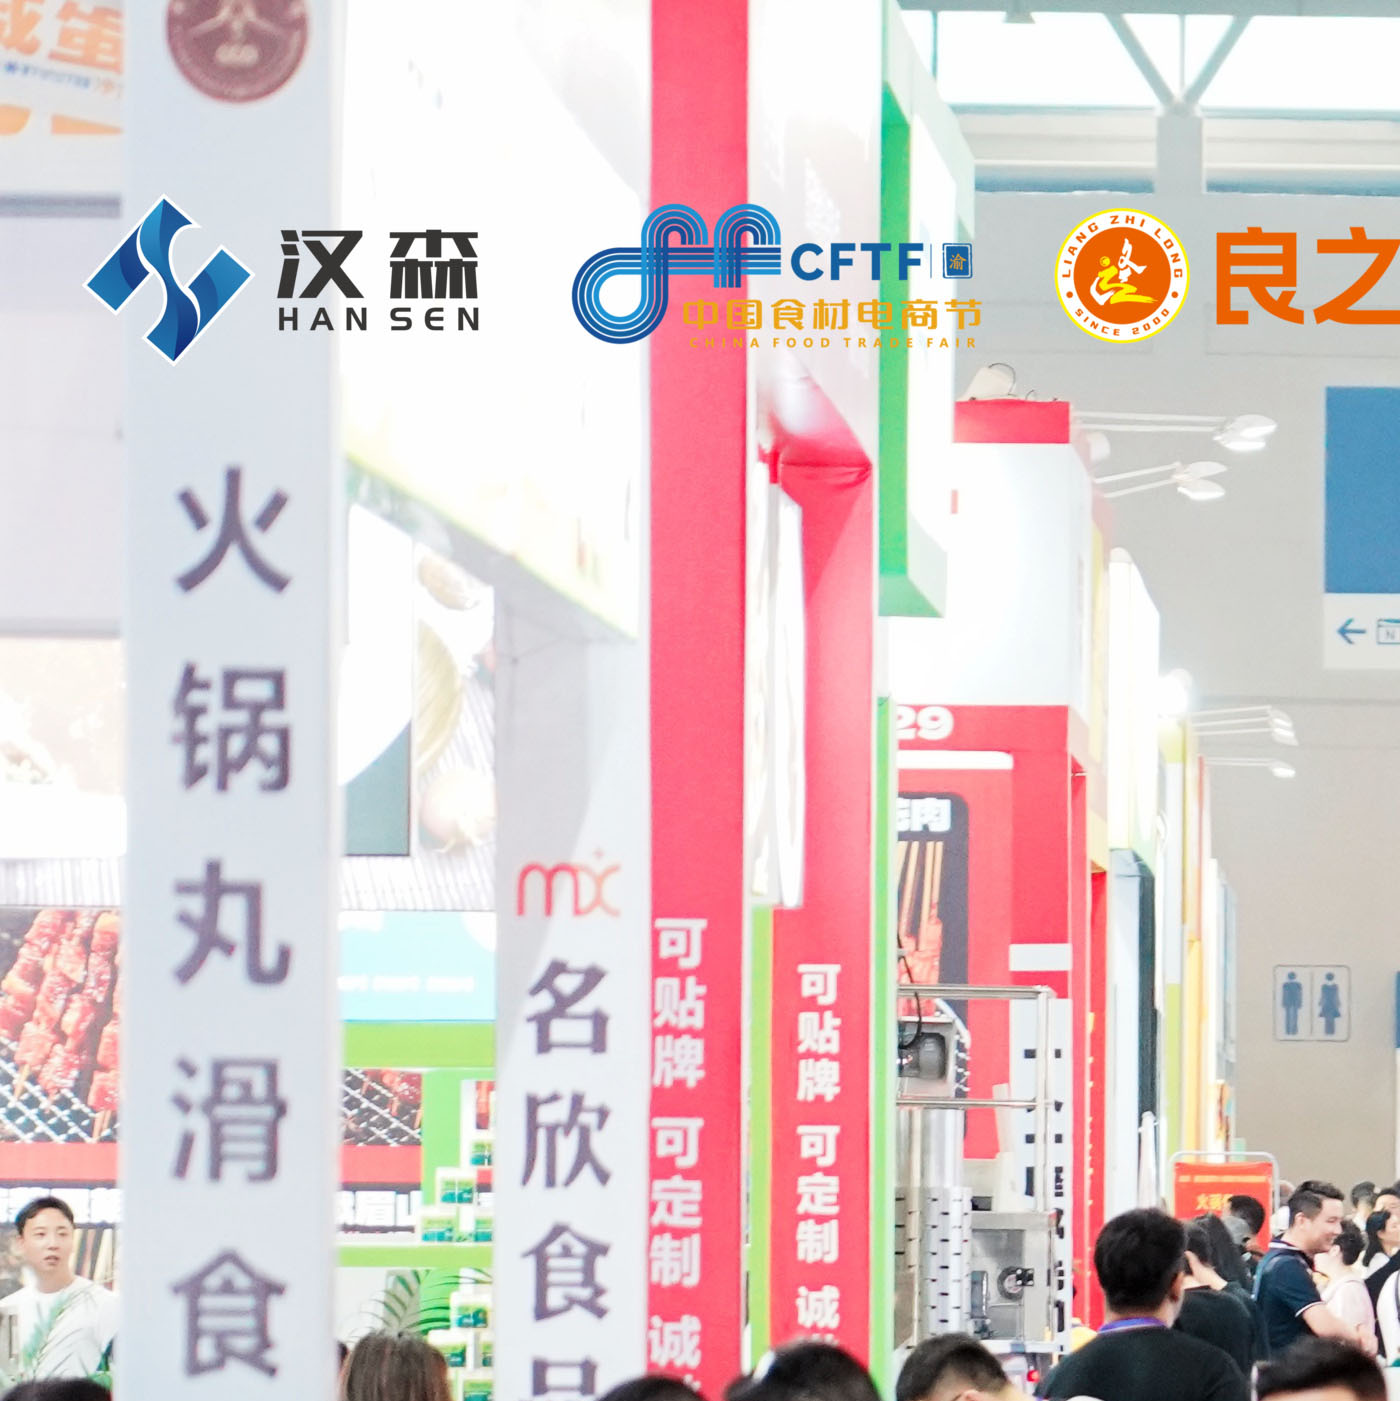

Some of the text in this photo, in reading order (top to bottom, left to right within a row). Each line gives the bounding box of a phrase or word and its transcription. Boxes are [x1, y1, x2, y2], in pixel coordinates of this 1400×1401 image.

[652, 918, 707, 1089] 可贴牌
[796, 963, 841, 1102] 可贴牌
[649, 1116, 704, 1288] 可定制
[796, 1125, 841, 1264] 可定制
